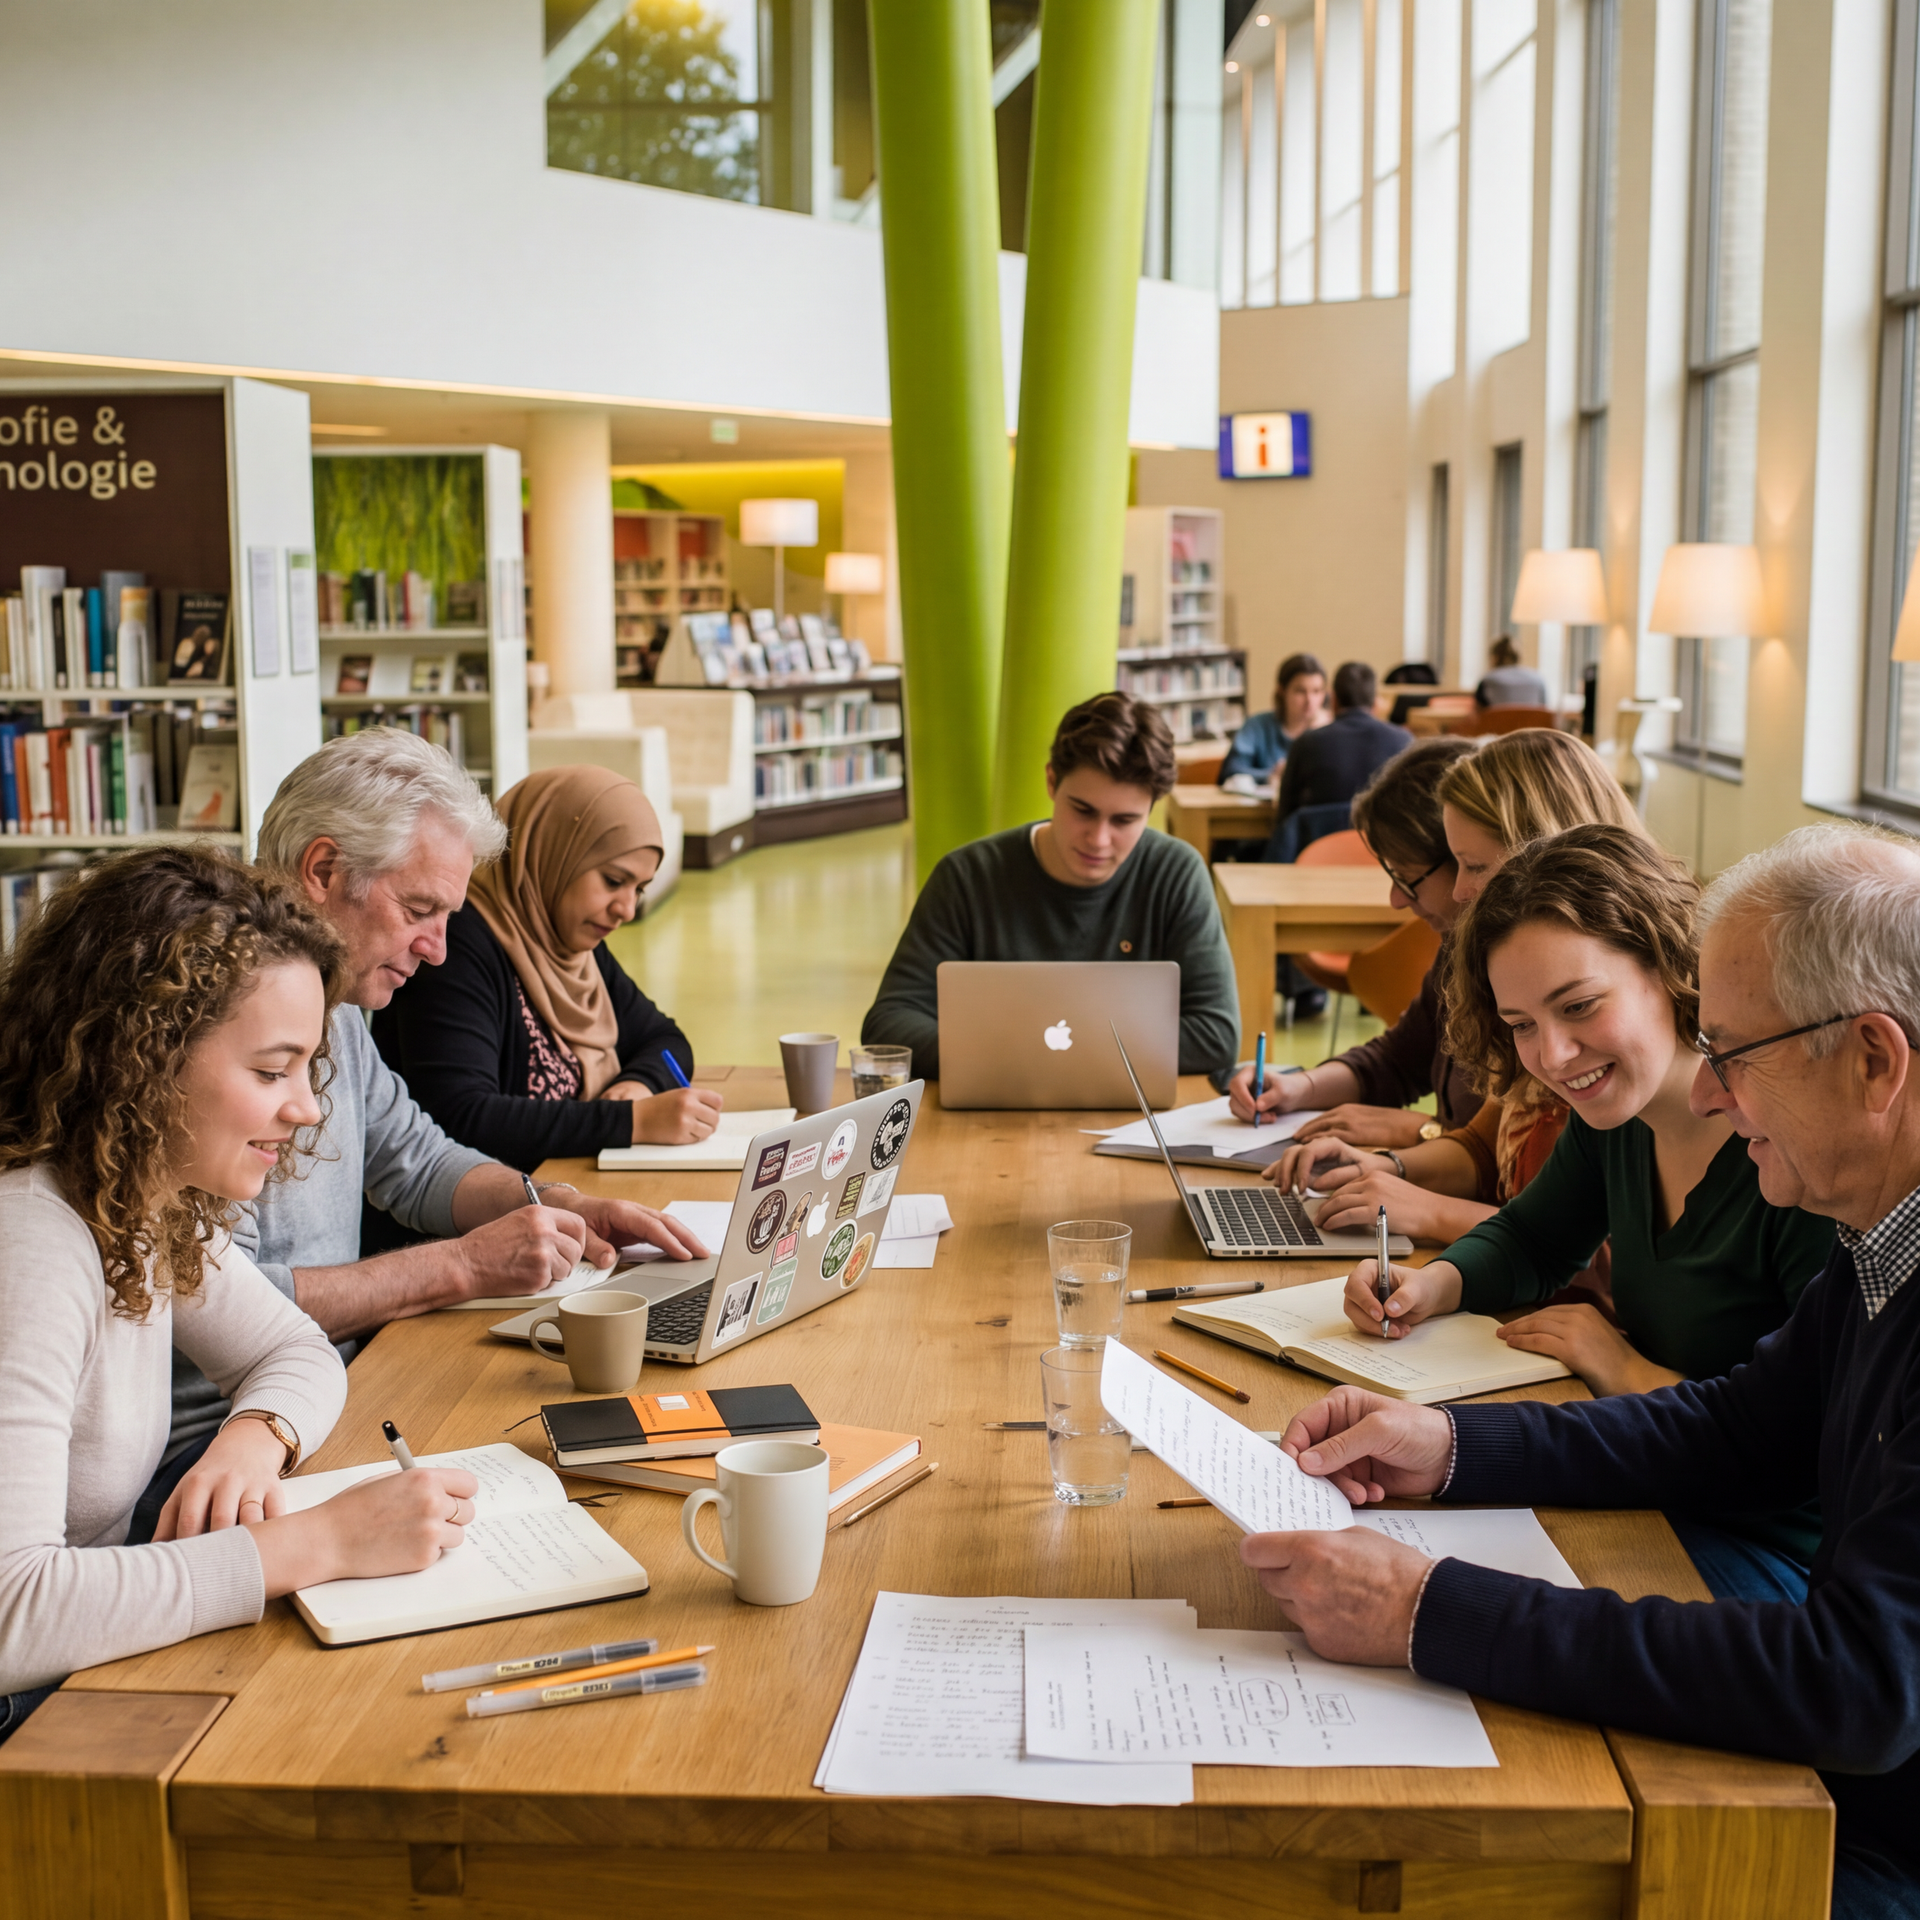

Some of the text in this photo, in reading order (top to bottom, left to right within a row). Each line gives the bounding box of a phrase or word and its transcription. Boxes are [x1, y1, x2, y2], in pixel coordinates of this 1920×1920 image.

[0, 405, 125, 446] ofie &
[1258, 426, 1269, 468] i
